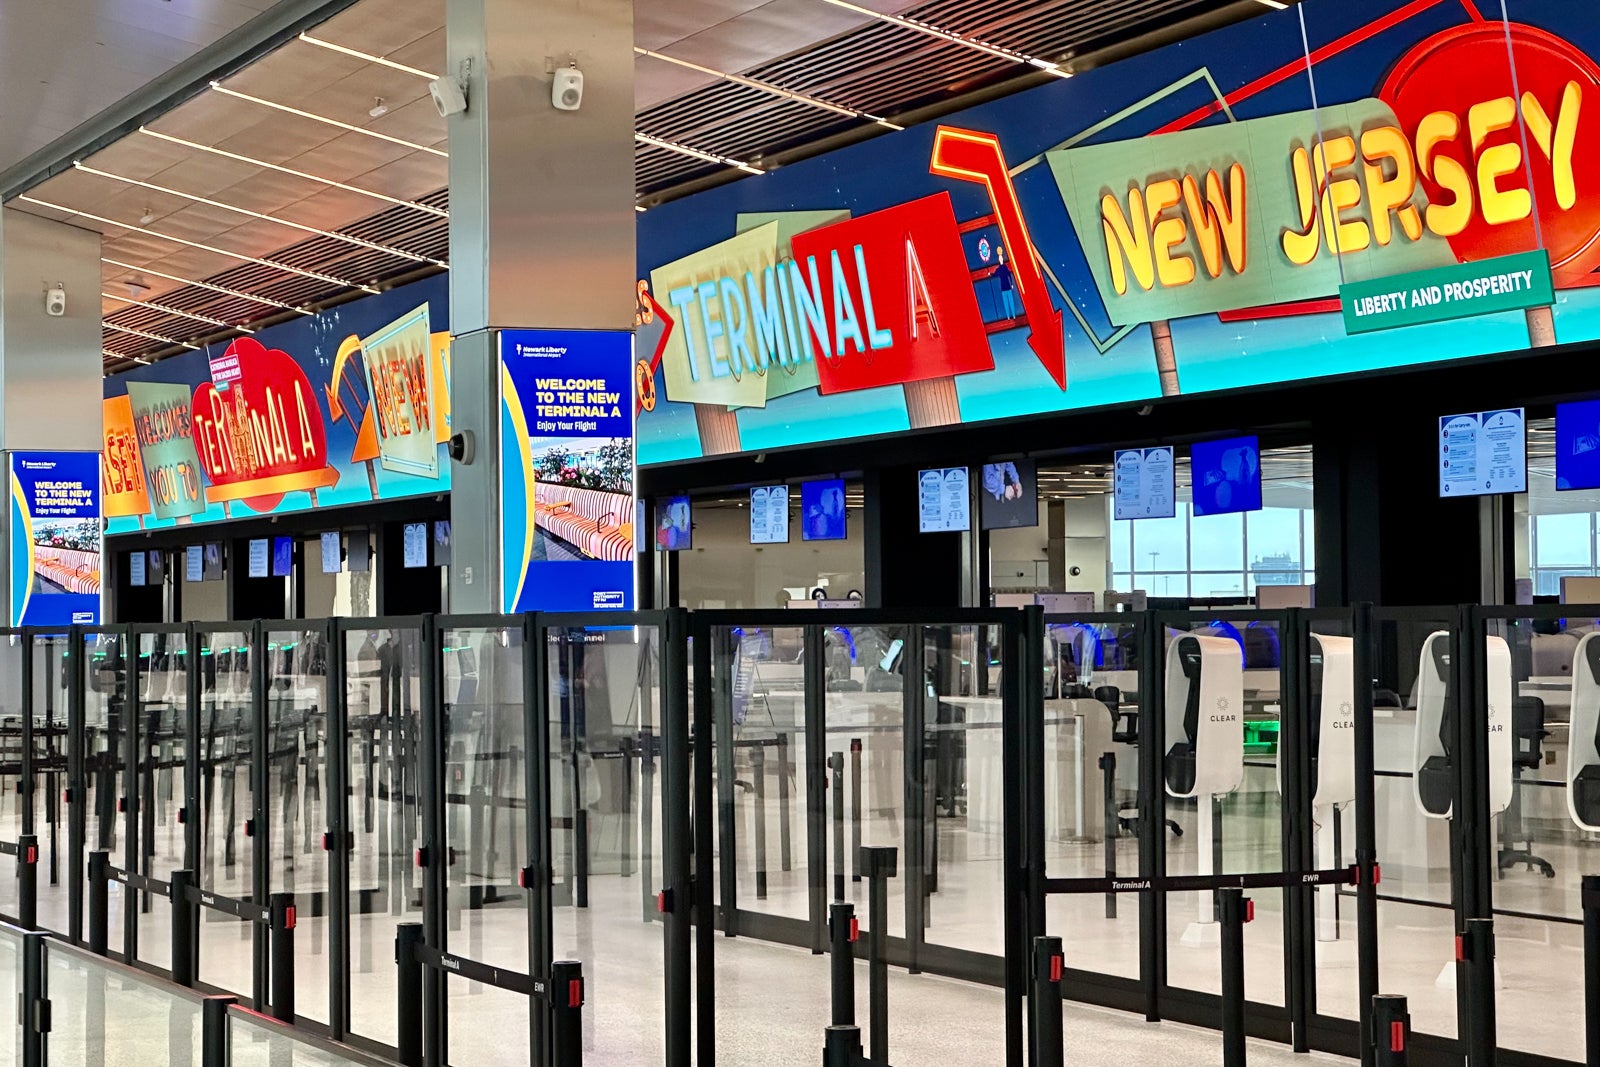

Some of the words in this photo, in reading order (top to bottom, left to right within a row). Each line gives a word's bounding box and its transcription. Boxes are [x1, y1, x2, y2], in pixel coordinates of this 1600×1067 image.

[1101, 161, 1247, 296] NEW
[1282, 80, 1583, 266] JERSEY
[1354, 290, 1407, 317] LIBERTY
[1411, 286, 1442, 308] AND
[1444, 270, 1532, 302] PROSPERITY
[669, 244, 893, 382] TERMINAL
[905, 231, 941, 342] A
[536, 378, 606, 390] WELCOME
[369, 352, 430, 439] NEW
[536, 392, 555, 404] TO
[557, 392, 584, 404] THE
[587, 392, 620, 404] NEW
[536, 405, 608, 418] TERMINAL
[610, 406, 622, 418] A
[134, 404, 192, 447] WELCOMES
[294, 380, 316, 459] A
[536, 421, 556, 432] Enjoy
[557, 421, 574, 431] Your
[574, 421, 597, 432] Flight!
[34, 481, 82, 489] WELCOME
[150, 463, 179, 506] YOU
[176, 462, 198, 501] TO
[1112, 881, 1144, 889] Terminal
[1144, 880, 1151, 889] A
[441, 956, 456, 968] Terminal
[455, 962, 460, 970] A
[534, 981, 545, 993] EWR
